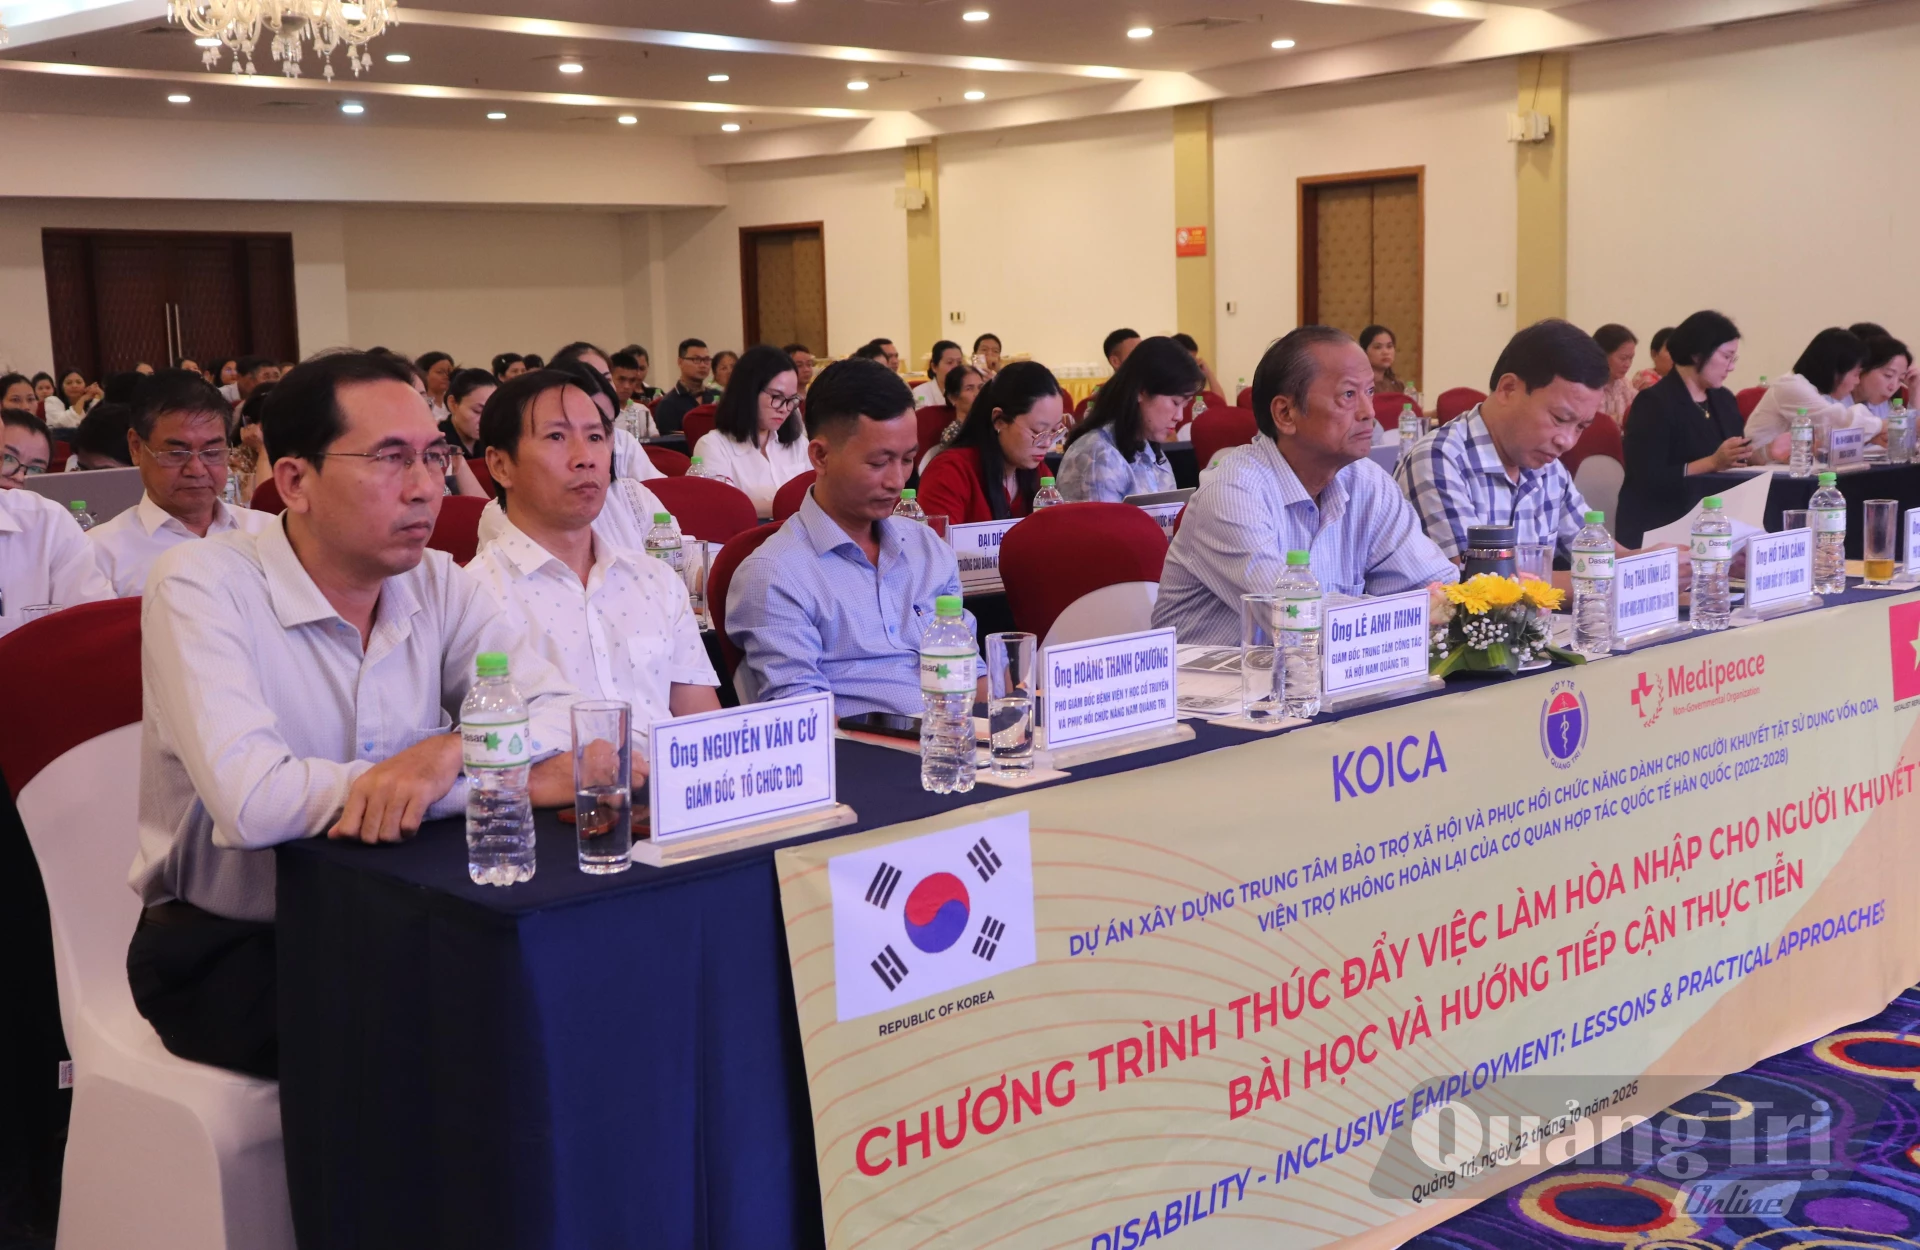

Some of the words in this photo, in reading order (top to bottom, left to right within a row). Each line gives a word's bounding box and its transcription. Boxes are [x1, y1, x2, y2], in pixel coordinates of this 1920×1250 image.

[978, 534, 990, 549] ĐẠI
[992, 530, 1005, 546] DIỆ
[973, 557, 981, 570] CAO
[1332, 618, 1352, 642] Ông
[1355, 613, 1367, 637] LÊ
[1370, 612, 1391, 634] ANH
[1394, 607, 1421, 629] MINH
[1054, 661, 1072, 689] Ông
[1074, 656, 1103, 684] HOÀNG
[1106, 653, 1132, 678] THANH
[1135, 646, 1168, 673] CHƯƠNG
[1332, 650, 1347, 664] GIÁM
[1349, 646, 1360, 661] ĐỐC
[1362, 645, 1380, 658] TRUNG
[1381, 641, 1393, 654] TÂM
[1395, 638, 1410, 652] CÔNG
[1411, 635, 1422, 648] TÁC
[1345, 664, 1352, 679] XÃ
[1354, 664, 1363, 679] HỘI
[1365, 663, 1378, 675] NAM
[1380, 657, 1399, 672] QUẢNG
[1400, 656, 1409, 668] TRỊ
[1055, 698, 1066, 712] PHÓ
[1068, 695, 1082, 710] GIÁM
[1084, 691, 1095, 706] ĐỐC
[1096, 690, 1110, 706] BỆNH
[1112, 688, 1124, 702] VIỆN
[1129, 686, 1139, 699] HỌC
[1141, 680, 1148, 695] CỔ
[1149, 677, 1169, 693] TRUYỀN
[1668, 654, 1765, 698] Medipeace
[1059, 715, 1066, 730] VÀ
[1067, 716, 1082, 730] PHỤC
[1084, 710, 1093, 724] HỒI
[1095, 707, 1109, 723] CHỨC
[1110, 705, 1124, 720] NĂNG
[1126, 704, 1138, 716] NAM
[1139, 698, 1157, 714] QUẢNG
[1158, 698, 1166, 710] TRỊ
[1673, 693, 1726, 716] Non-Governmental
[1727, 686, 1761, 702] Organization
[670, 736, 698, 769] Ông
[703, 719, 760, 762] NGUYỄN
[765, 717, 793, 749] VĂN
[798, 708, 818, 743] CỬ
[685, 778, 712, 810] GIÁM
[715, 770, 735, 804] ĐỐC
[741, 763, 753, 798] TỔ
[756, 763, 782, 795] CHỨC
[786, 763, 803, 789] DrD
[1332, 730, 1448, 803] KOICA
[1069, 924, 1100, 956] DỰ
[1105, 918, 1133, 946] ÁN
[1139, 904, 1176, 935] XÂY
[1182, 888, 1234, 921] DỰNG
[1239, 869, 1298, 903] TRUNG
[1302, 857, 1337, 883] TÂM
[1342, 843, 1375, 871] BẢO
[1379, 831, 1410, 858] TRỢ
[1413, 823, 1433, 849] XÃ
[1437, 816, 1462, 842] HỘI
[1465, 808, 1485, 831] VÀ
[1488, 799, 1525, 825] PHỤC
[1529, 786, 1551, 813] HỒI
[1554, 778, 1589, 804] CHỨC
[1592, 768, 1627, 793] NĂNG
[1630, 759, 1663, 782] DÀNH
[1666, 750, 1690, 770] CHO
[1693, 737, 1727, 763] NGƯỜI
[1730, 723, 1770, 752] KHUYẾT
[1771, 719, 1789, 741] TẬT
[1792, 713, 1805, 733] SỬ
[1807, 709, 1835, 731] DỤNG
[1837, 700, 1857, 720] VỐN
[1860, 698, 1879, 715] ODA
[1257, 903, 1298, 932] VIỆN
[1302, 888, 1335, 916] TRỢ
[1340, 872, 1395, 907] KHÔNG
[1399, 857, 1441, 886] HOÀN
[1445, 848, 1466, 872] LẠI
[1470, 836, 1498, 862] CỦA
[1502, 828, 1521, 851] CƠ
[1524, 818, 1561, 846] QUAN
[1565, 808, 1591, 832] HỢP
[1595, 799, 1618, 821] TÁC
[1620, 785, 1655, 815] QUỐC
[1657, 778, 1671, 801] TẾ
[1674, 773, 1697, 796] HÀN
[1700, 761, 1731, 790] QUỐC
[1734, 747, 1789, 781] (2022-2028)
[855, 1060, 1076, 1176] CHƯƠNG
[1088, 1007, 1217, 1092] TRÌNH
[1228, 966, 1331, 1040] THÚC
[1340, 931, 1411, 1000] ĐẨY
[1417, 909, 1488, 967] VIỆC
[1497, 884, 1557, 940] LÀM
[1565, 861, 1627, 915] HÒA
[1633, 833, 1702, 890] NHẬP
[1709, 816, 1760, 860] CHO
[1766, 785, 1837, 842] NGƯỜI
[1844, 756, 1915, 816] KHUYẾT
[1229, 1056, 1291, 1121] BÀI
[1303, 1024, 1379, 1090] HỌC
[1387, 995, 1432, 1051] VÀ
[1441, 955, 1549, 1032] HƯỚNG
[1556, 921, 1617, 981] TIẾP
[1624, 905, 1676, 957] CẬN
[1682, 877, 1750, 931] THỰC
[1754, 850, 1804, 902] TIỄN
[878, 1008, 935, 1037] REPUBLIC
[938, 1002, 954, 1017] OF
[957, 990, 994, 1011] KOREA
[1091, 1166, 1252, 1250] DISABILITY
[1275, 1097, 1406, 1185] INCLUSIVE
[1411, 1029, 1566, 1121] EMPLOYMENT:
[1571, 988, 1656, 1049] LESSONS
[1660, 982, 1673, 1007] &
[1677, 940, 1773, 1001] PRACTICAL
[1776, 899, 1887, 961] APPROACHES
[1412, 1170, 1455, 1203] Quảng
[1460, 1156, 1478, 1178] Trị,
[1482, 1142, 1512, 1168] ngày
[1514, 1132, 1528, 1152] 22
[1531, 1115, 1566, 1143] tháng
[1569, 1106, 1581, 1125] 10
[1584, 1096, 1609, 1118] năm
[1612, 1080, 1638, 1105] 2026
